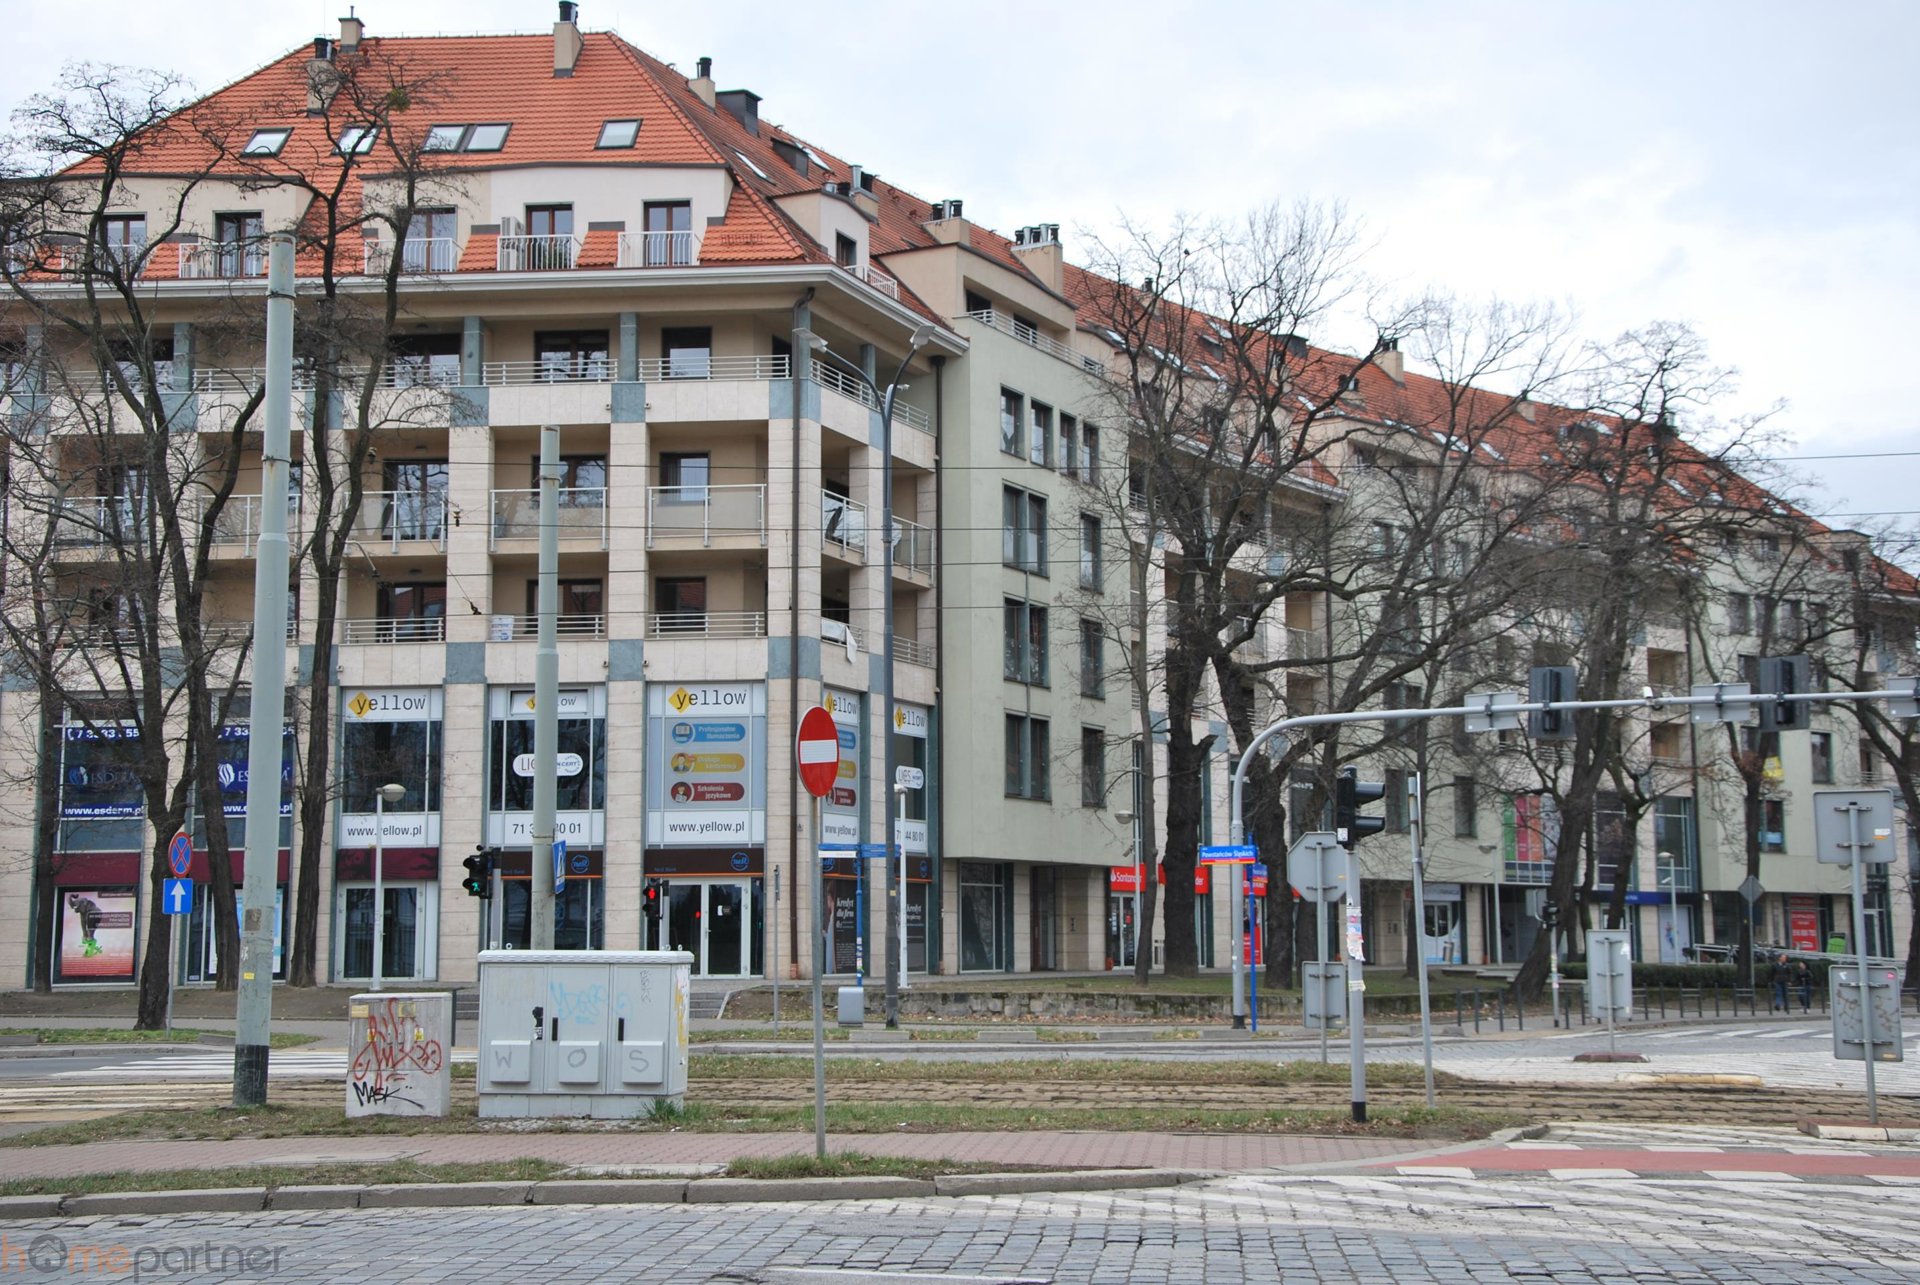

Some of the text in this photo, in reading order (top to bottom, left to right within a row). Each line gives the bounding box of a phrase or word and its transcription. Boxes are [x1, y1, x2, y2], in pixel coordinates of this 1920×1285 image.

[356, 695, 426, 715] yellow
[676, 689, 747, 710] yellow
[347, 825, 422, 837] www.ellow.pl
[669, 821, 745, 834] www.yellow.pl
[1116, 872, 1142, 883] Santanr
